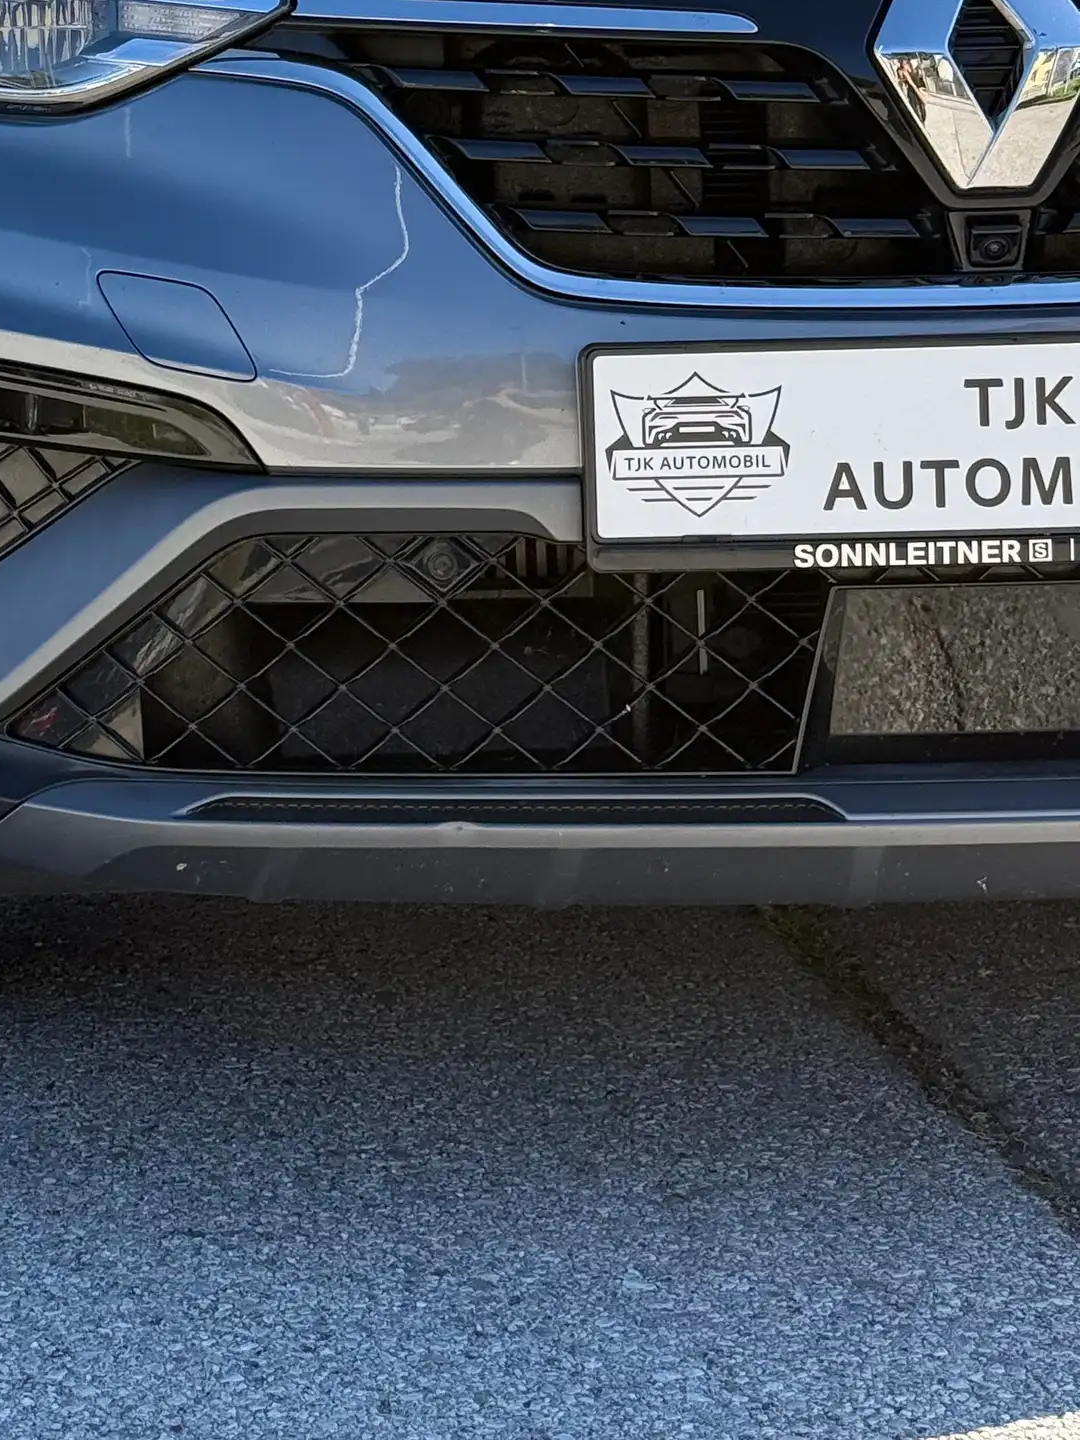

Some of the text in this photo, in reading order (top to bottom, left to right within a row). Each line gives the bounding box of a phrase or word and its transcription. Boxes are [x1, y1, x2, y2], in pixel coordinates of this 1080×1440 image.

[963, 375, 1077, 430] TJK
[623, 453, 772, 472] TJK AUTOMOBIL
[823, 456, 1074, 511] AUTOM
[793, 539, 1022, 568] SONNLEITNER
